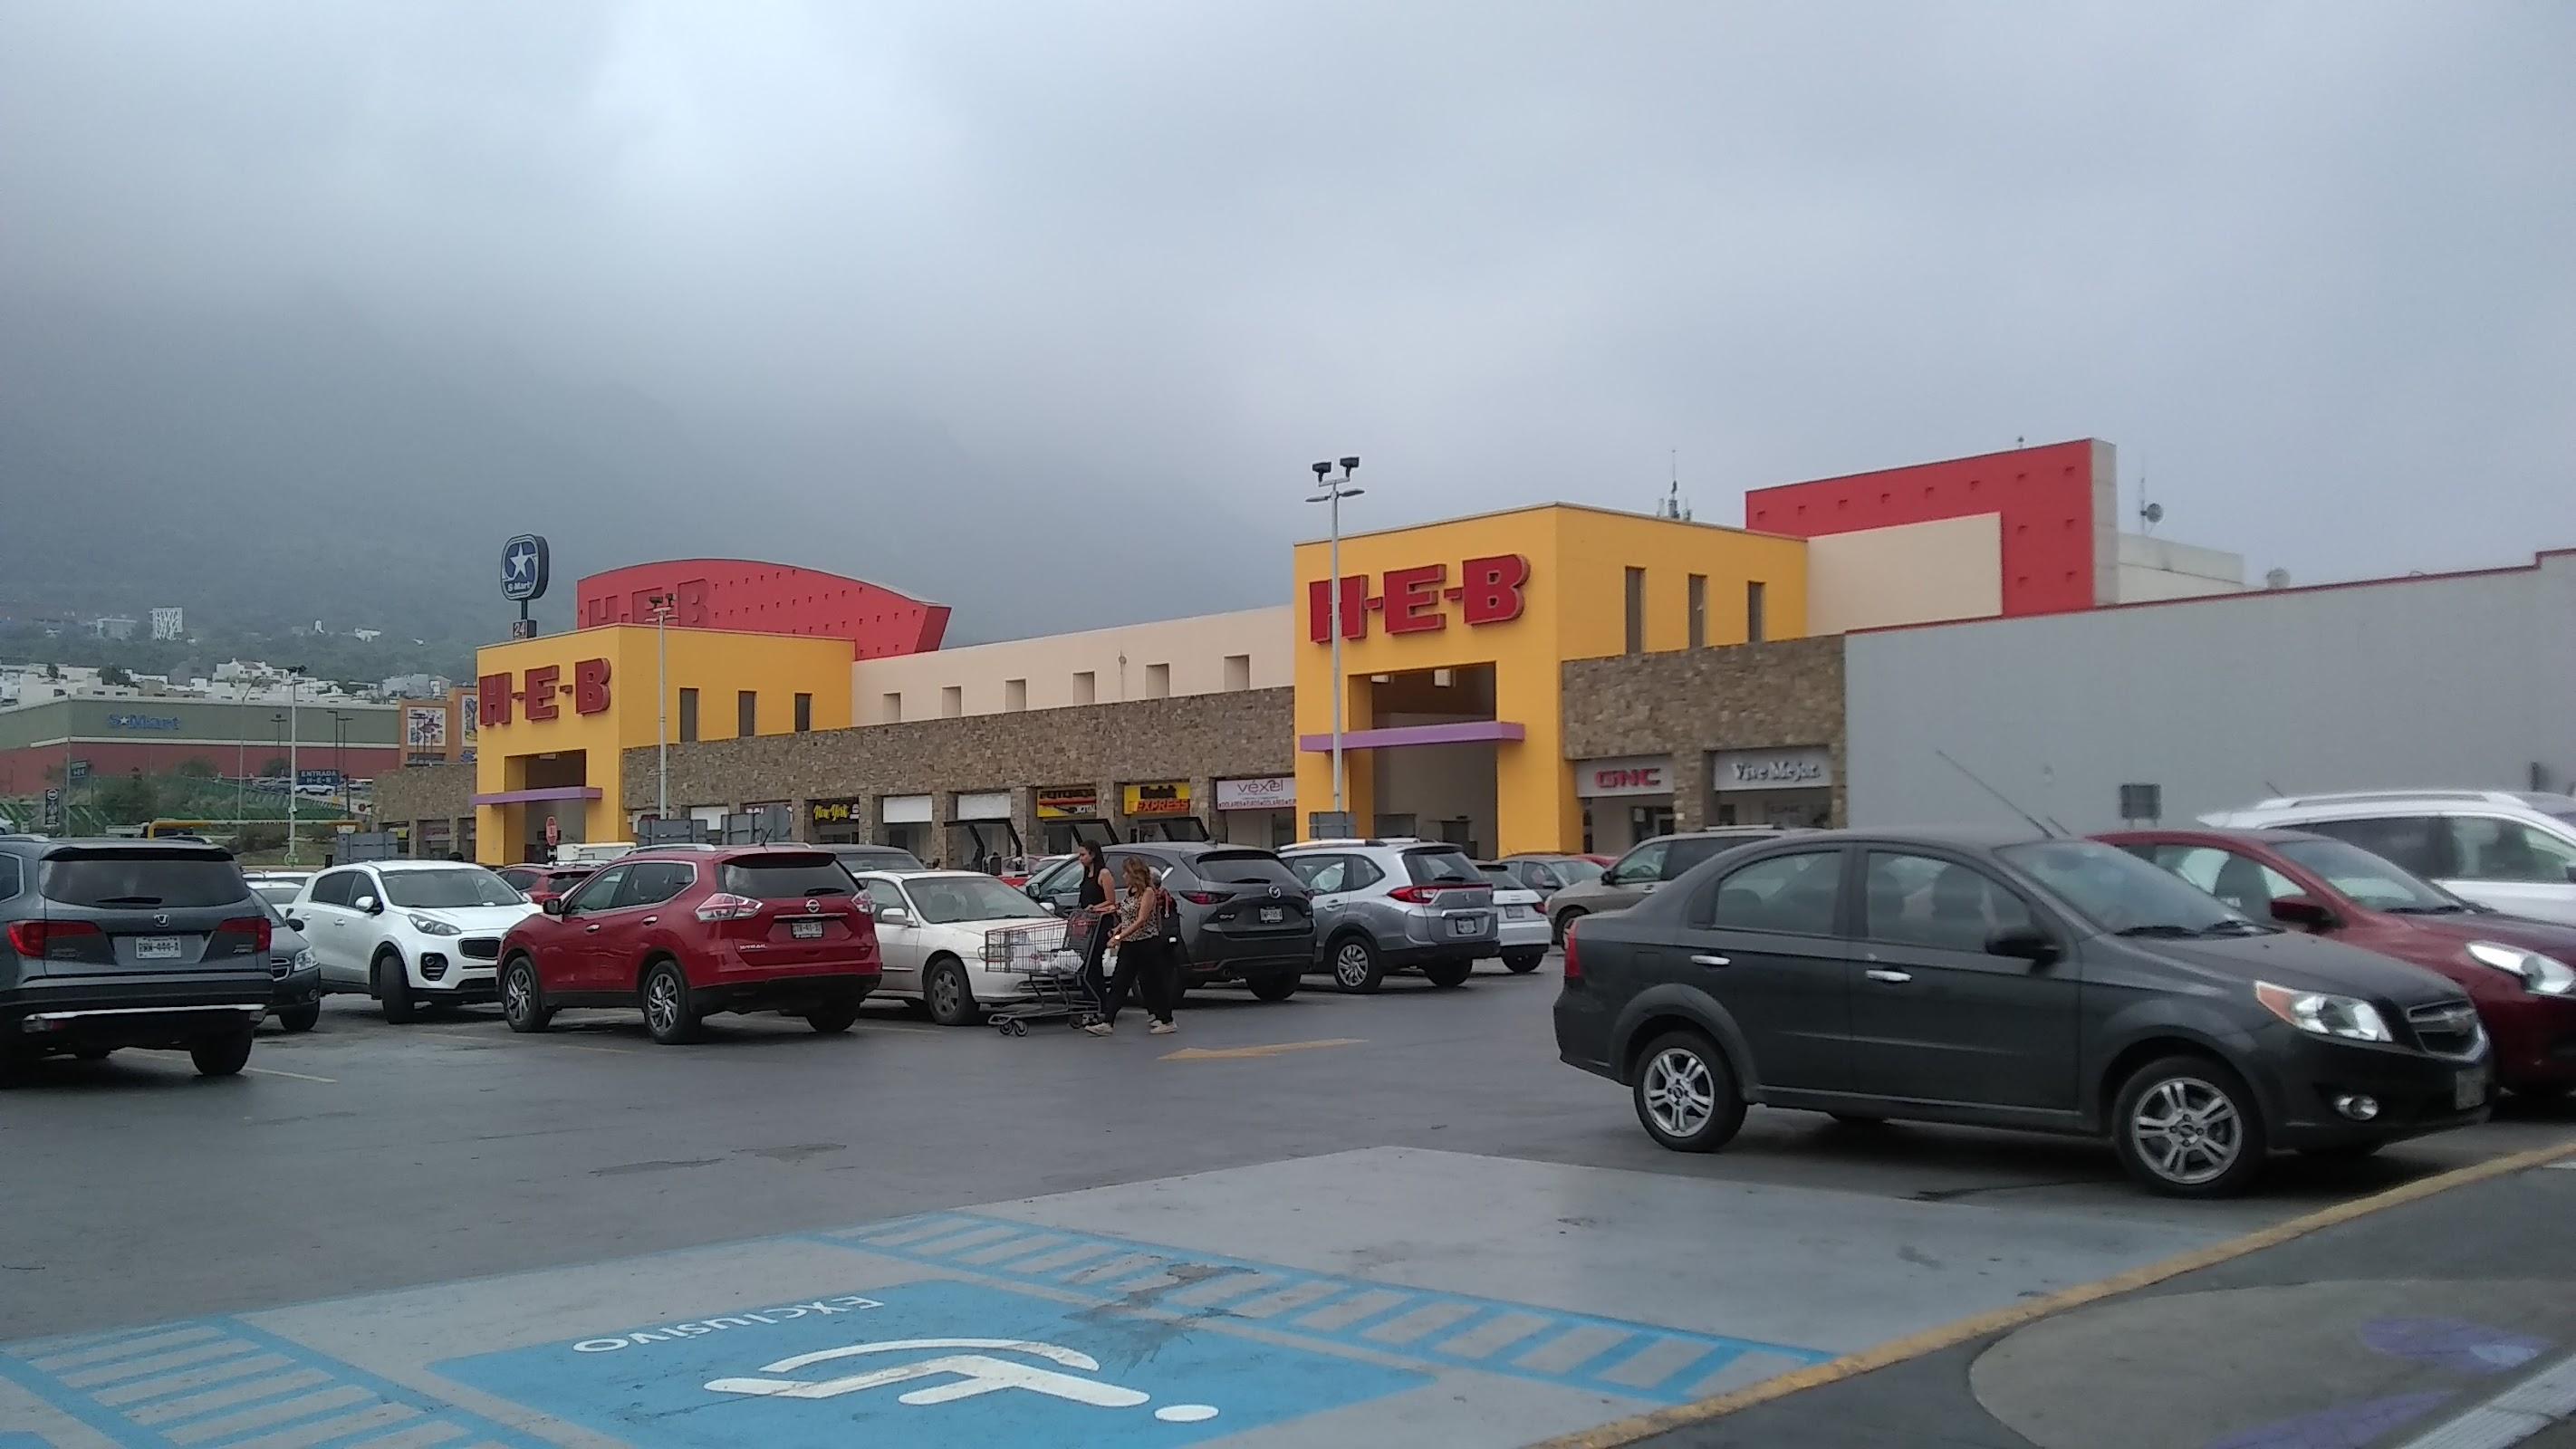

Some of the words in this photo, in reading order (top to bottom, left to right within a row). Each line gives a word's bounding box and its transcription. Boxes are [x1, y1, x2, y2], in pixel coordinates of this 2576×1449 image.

[1309, 553, 1531, 645] H-E-B
[514, 622, 526, 637] 24
[479, 657, 611, 726] H-E-B
[301, 769, 337, 777] ENTRADA
[1594, 768, 1661, 789] GNC
[1136, 799, 1189, 812] EXPRESS
[572, 1295, 885, 1353] EXCLUSIVO
